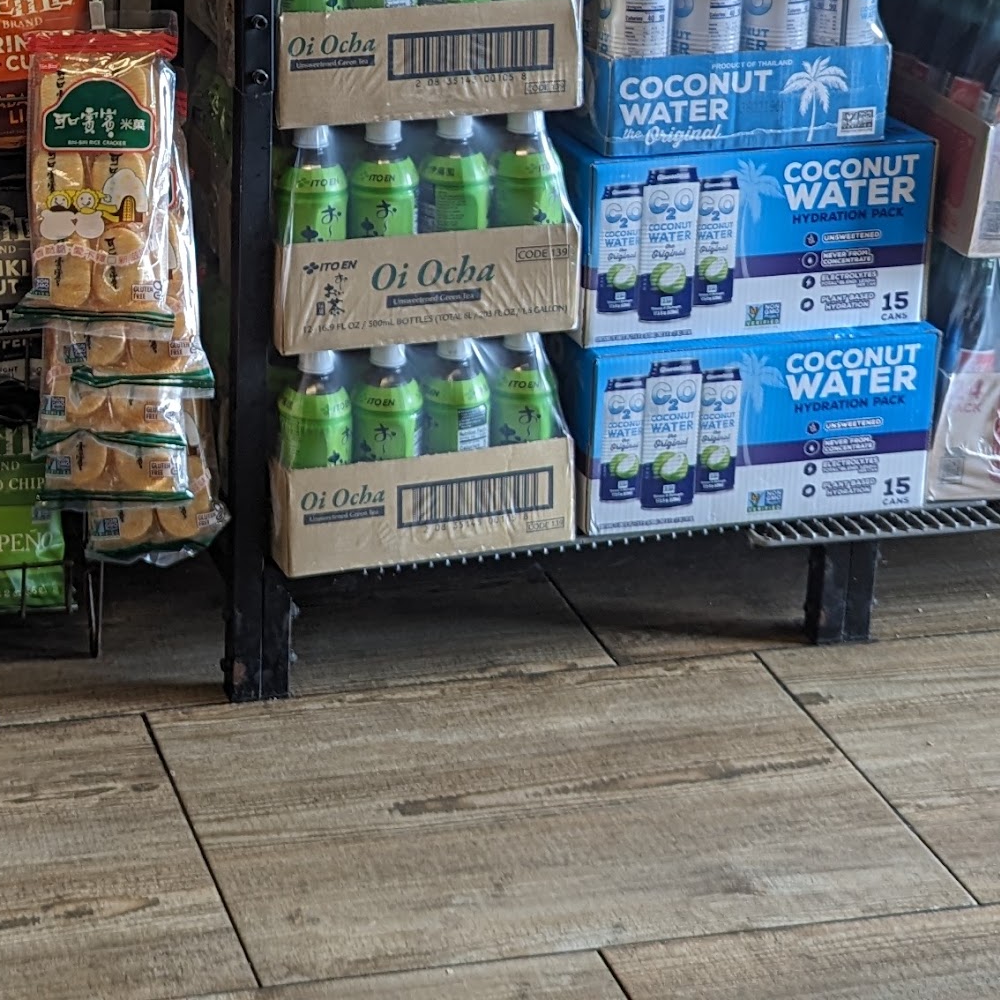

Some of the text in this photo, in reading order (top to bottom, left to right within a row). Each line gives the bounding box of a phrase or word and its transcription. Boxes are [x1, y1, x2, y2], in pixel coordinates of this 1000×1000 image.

[2, 16, 43, 29] BRAND
[288, 32, 376, 57] Oi Ocha
[712, 58, 794, 70] PRODUCT THAILAND
[619, 69, 773, 101] COCONUT
[619, 100, 729, 126] WATER
[622, 125, 722, 149] the Original
[783, 154, 920, 184] COCONUT
[783, 176, 916, 211] WATER
[792, 206, 905, 224] HYDRATION PACK
[648, 231, 692, 243] WATER
[823, 231, 880, 241] UNSWEETENED
[518, 247, 567, 259] CODE 139
[823, 249, 869, 259] NEVER FROM
[320, 260, 358, 271] ITO EN
[371, 254, 496, 291] Oi Ocha
[133, 284, 153, 299] GLUTEN FREE
[881, 291, 909, 312] 15
[397, 315, 433, 326] BOTTLES
[881, 312, 908, 321] CANS
[786, 343, 922, 374] COCONUT
[785, 366, 918, 401] WATER
[794, 394, 906, 413] HYDRATION PACK
[825, 420, 882, 430] UNSWEETENED
[883, 477, 910, 495] 15
[301, 484, 385, 511] Oi Ocha
[882, 497, 909, 506] CANS
